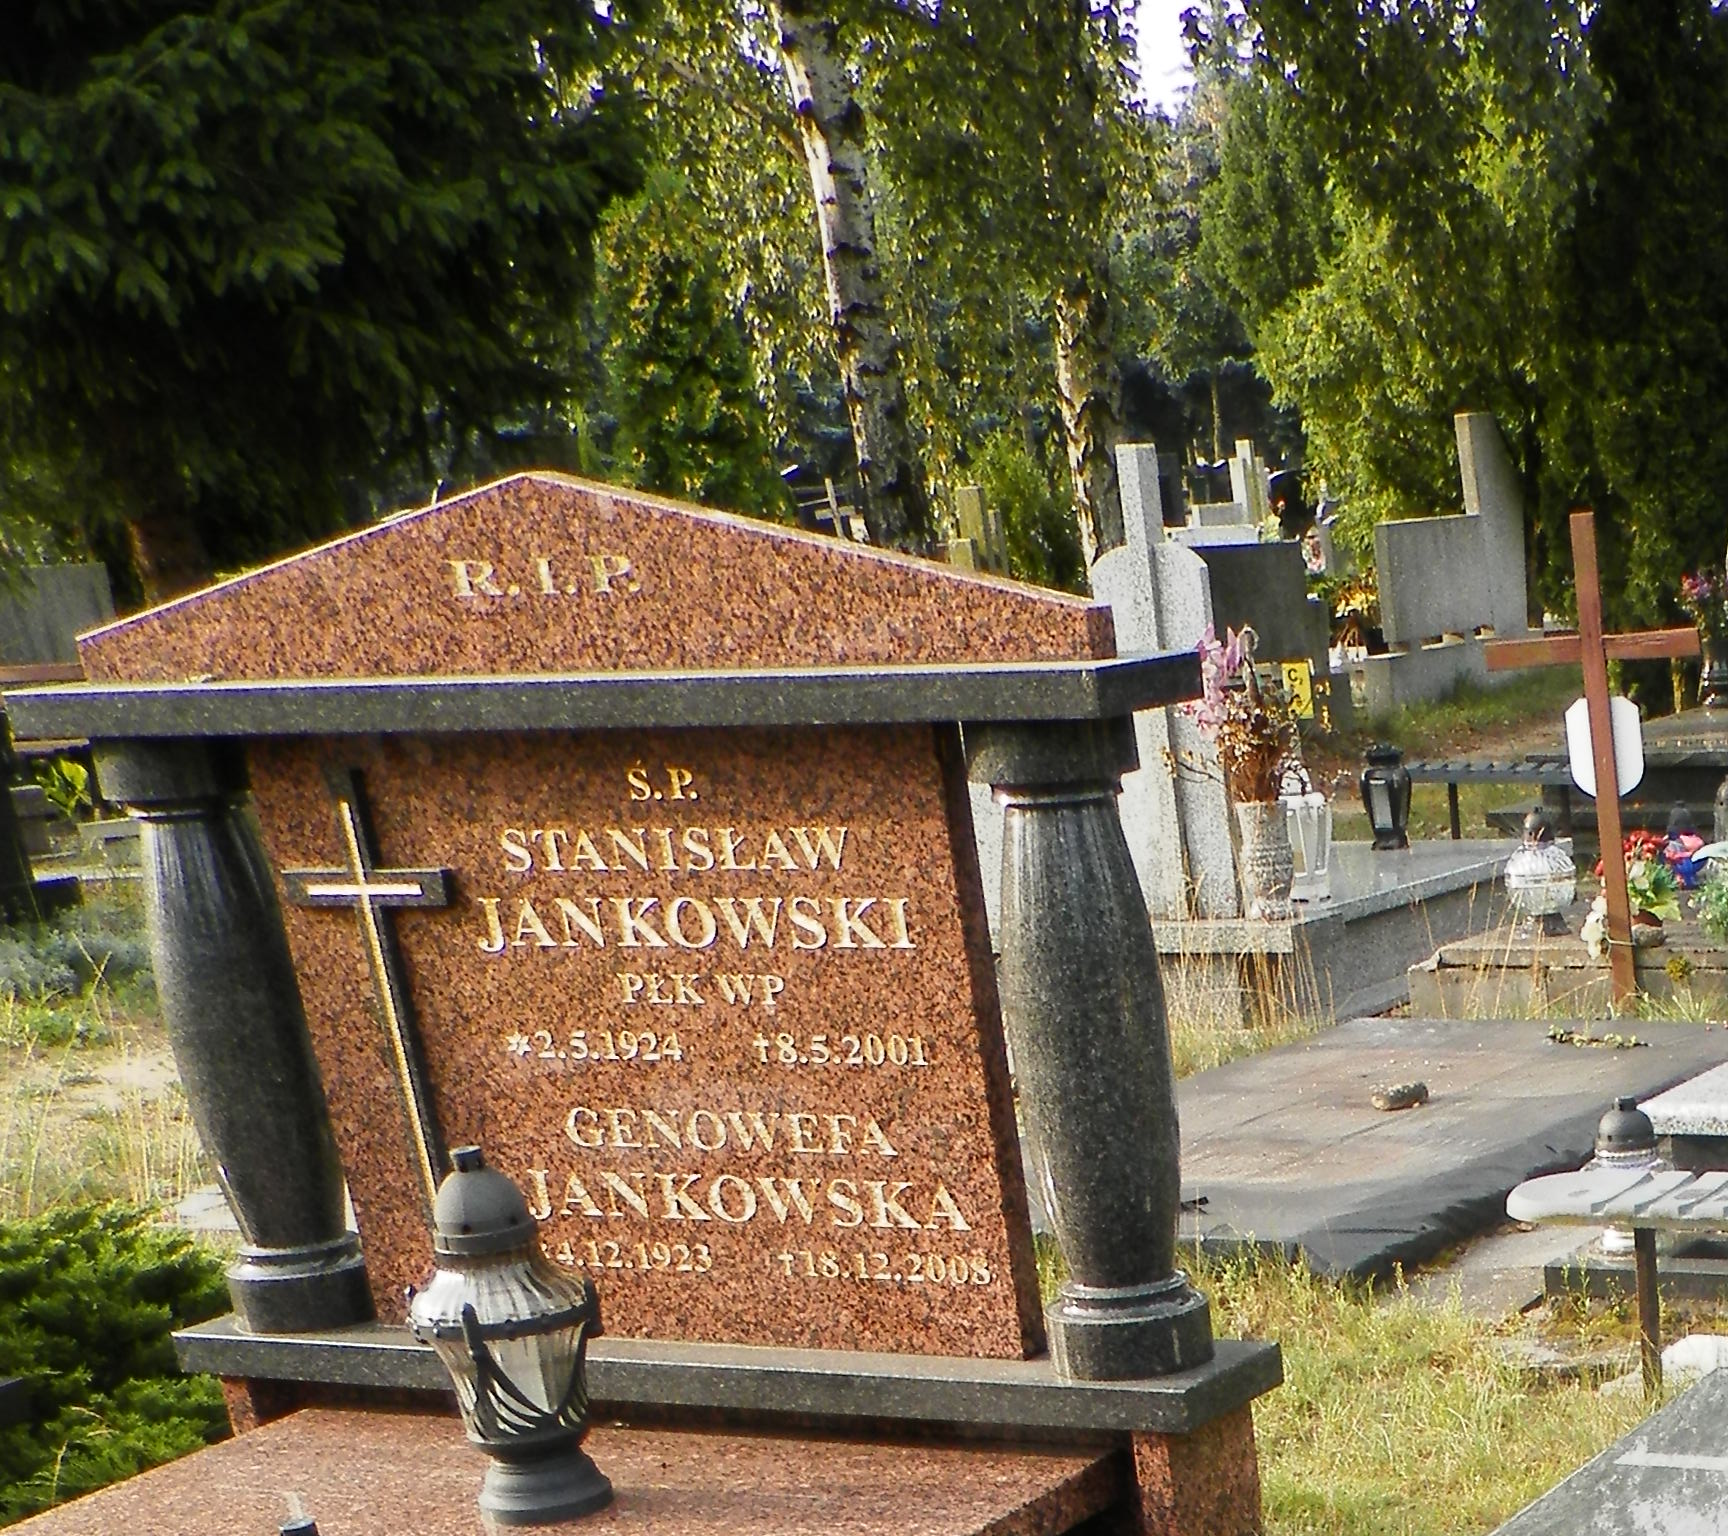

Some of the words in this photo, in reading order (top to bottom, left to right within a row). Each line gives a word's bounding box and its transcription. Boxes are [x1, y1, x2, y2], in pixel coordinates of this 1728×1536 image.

[627, 759, 699, 801] Ś.P.
[499, 826, 849, 873] STANISŁAW
[477, 896, 917, 954] JANKOWSKI
[616, 972, 705, 1005] PŁK
[713, 973, 785, 1007] WP
[563, 1106, 899, 1157] GENOWEFA
[525, 1168, 972, 1231] JANKOWSKA
[541, 1240, 713, 1273] 4.12.1923
